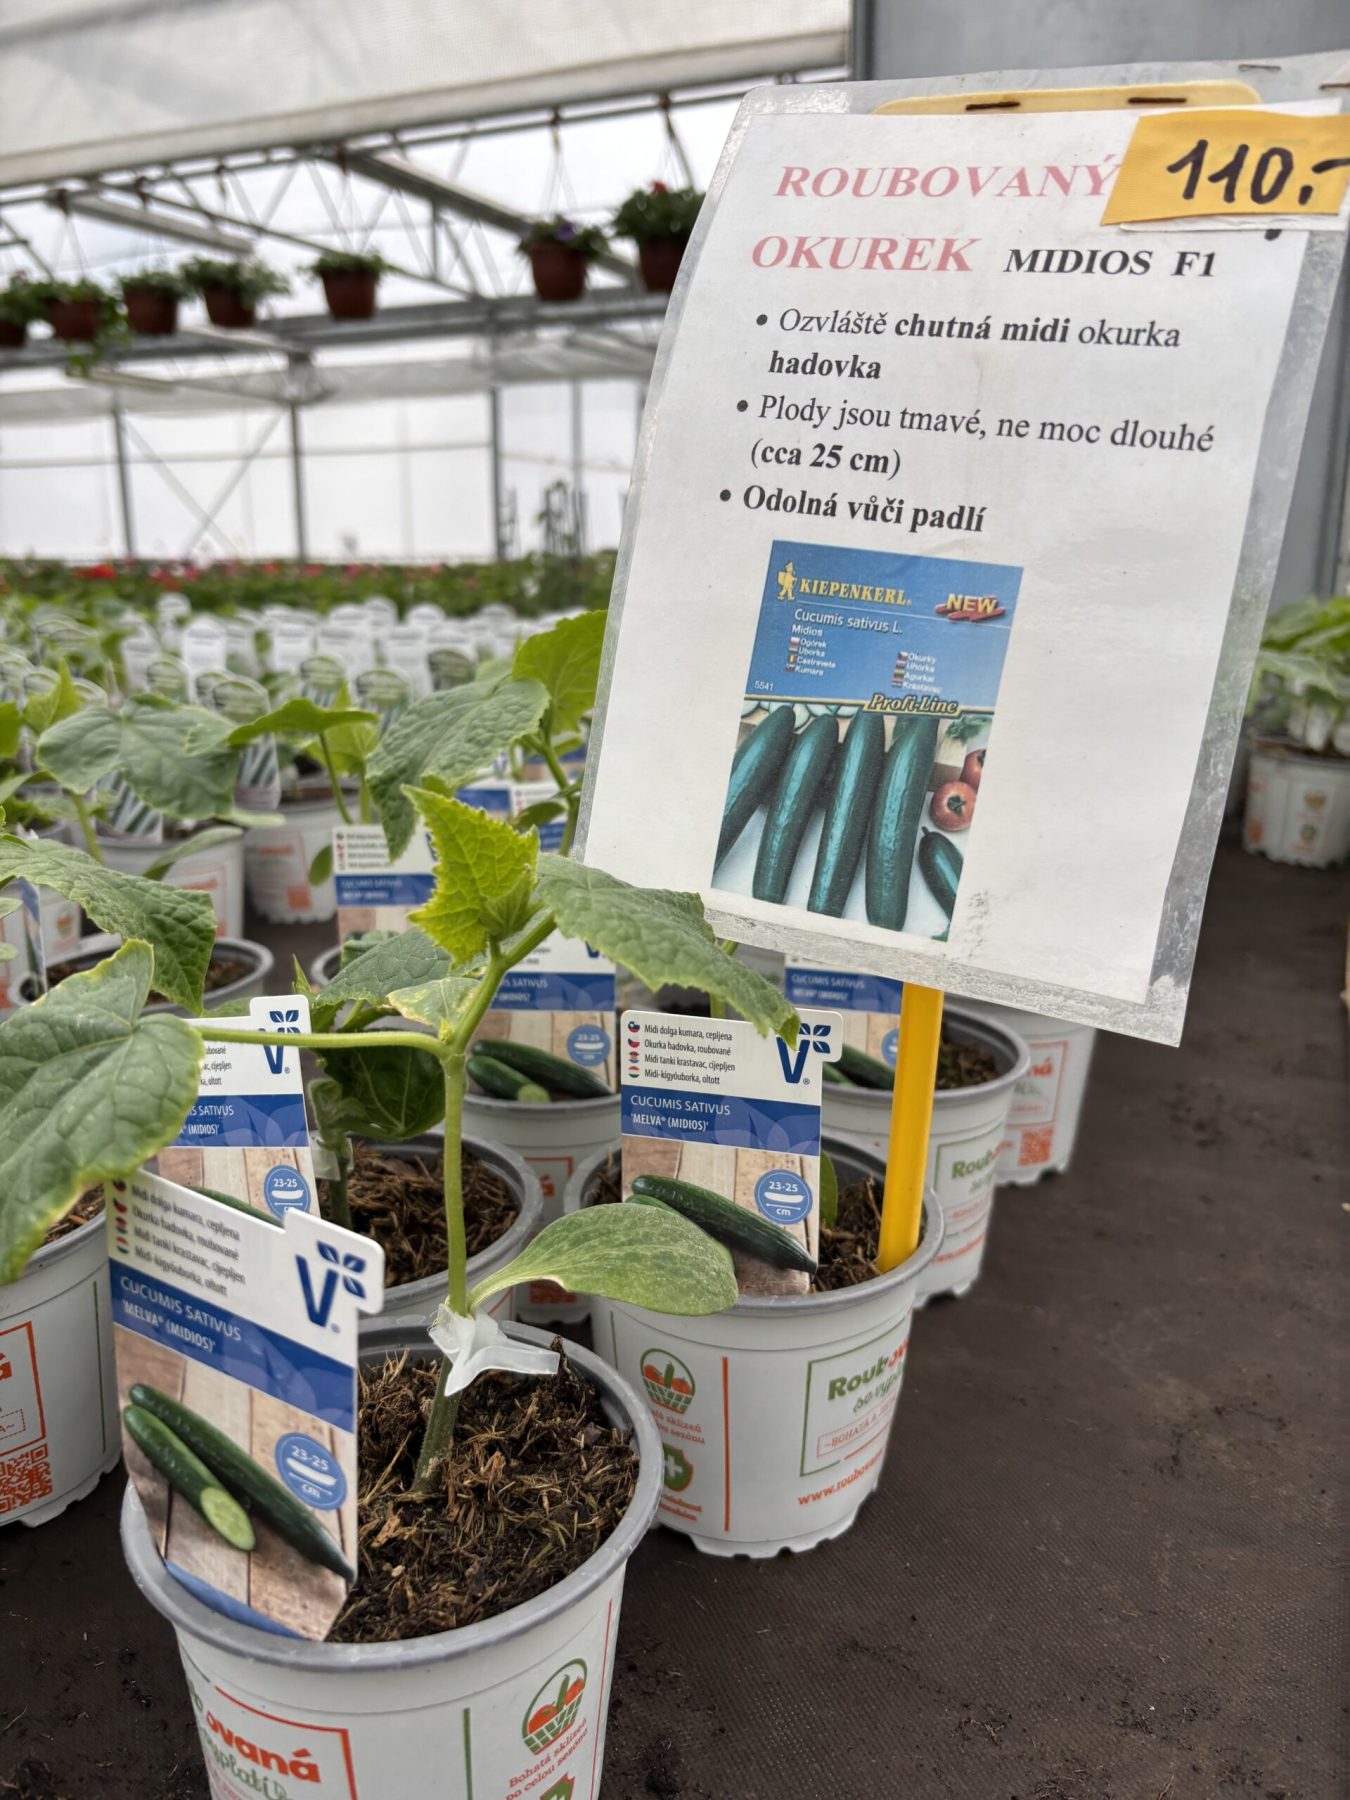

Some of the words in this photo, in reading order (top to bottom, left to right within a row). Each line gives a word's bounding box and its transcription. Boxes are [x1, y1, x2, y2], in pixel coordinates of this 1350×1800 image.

[773, 154, 1121, 198] ROUBOVANÝ
[752, 235, 982, 272] OKUREK
[1003, 248, 1153, 276] MIDIOS
[1171, 251, 1216, 278] F1
[779, 308, 889, 335] Ozvláště
[895, 313, 992, 340] chutná
[1000, 317, 1071, 343] midi
[1078, 319, 1181, 348] okurka
[768, 350, 882, 380] hadovka
[758, 395, 832, 429] Plody
[833, 399, 891, 431] jsou
[900, 407, 986, 441] tmavé,
[996, 417, 1030, 438] ne
[1038, 420, 1101, 444] moc
[1110, 419, 1215, 452] dlouhé
[751, 438, 801, 469] (cca
[809, 443, 843, 469] 25
[850, 448, 901, 481] cm)
[743, 485, 838, 518] Odolná
[848, 495, 904, 524] vůči
[909, 504, 987, 533] padlí
[946, 593, 998, 614] NEW
[791, 624, 823, 638] Midios
[794, 608, 844, 627] Cucumis
[847, 614, 889, 633] sativus
[892, 621, 904, 635] L.
[907, 653, 937, 665] Okurky
[754, 680, 774, 691] 5541
[511, 978, 548, 989] SATIVUS
[644, 1024, 659, 1034] Midi
[659, 1025, 677, 1038] dolga
[678, 1027, 705, 1039] kumara,
[705, 1031, 733, 1042] cepljena
[644, 1039, 667, 1050] Okurka
[667, 1041, 696, 1054] hadovka,
[697, 1045, 732, 1056] roubované
[644, 1054, 659, 1064] Midi
[659, 1056, 676, 1066] tanki
[676, 1057, 708, 1069] krastavac,
[708, 1061, 736, 1073] cijepljen
[702, 1075, 720, 1085] oltott
[198, 1104, 235, 1116] SATIVUS
[630, 1094, 682, 1110] CUCUMIS
[685, 1100, 731, 1116] SATIVUS
[273, 1177, 298, 1188] 23-25
[768, 1180, 799, 1192] 23-25
[776, 1207, 791, 1216] cm
[120, 1276, 183, 1315] CUCUMIS
[185, 1303, 242, 1342] SATIVUS
[291, 1444, 329, 1472] 23-25
